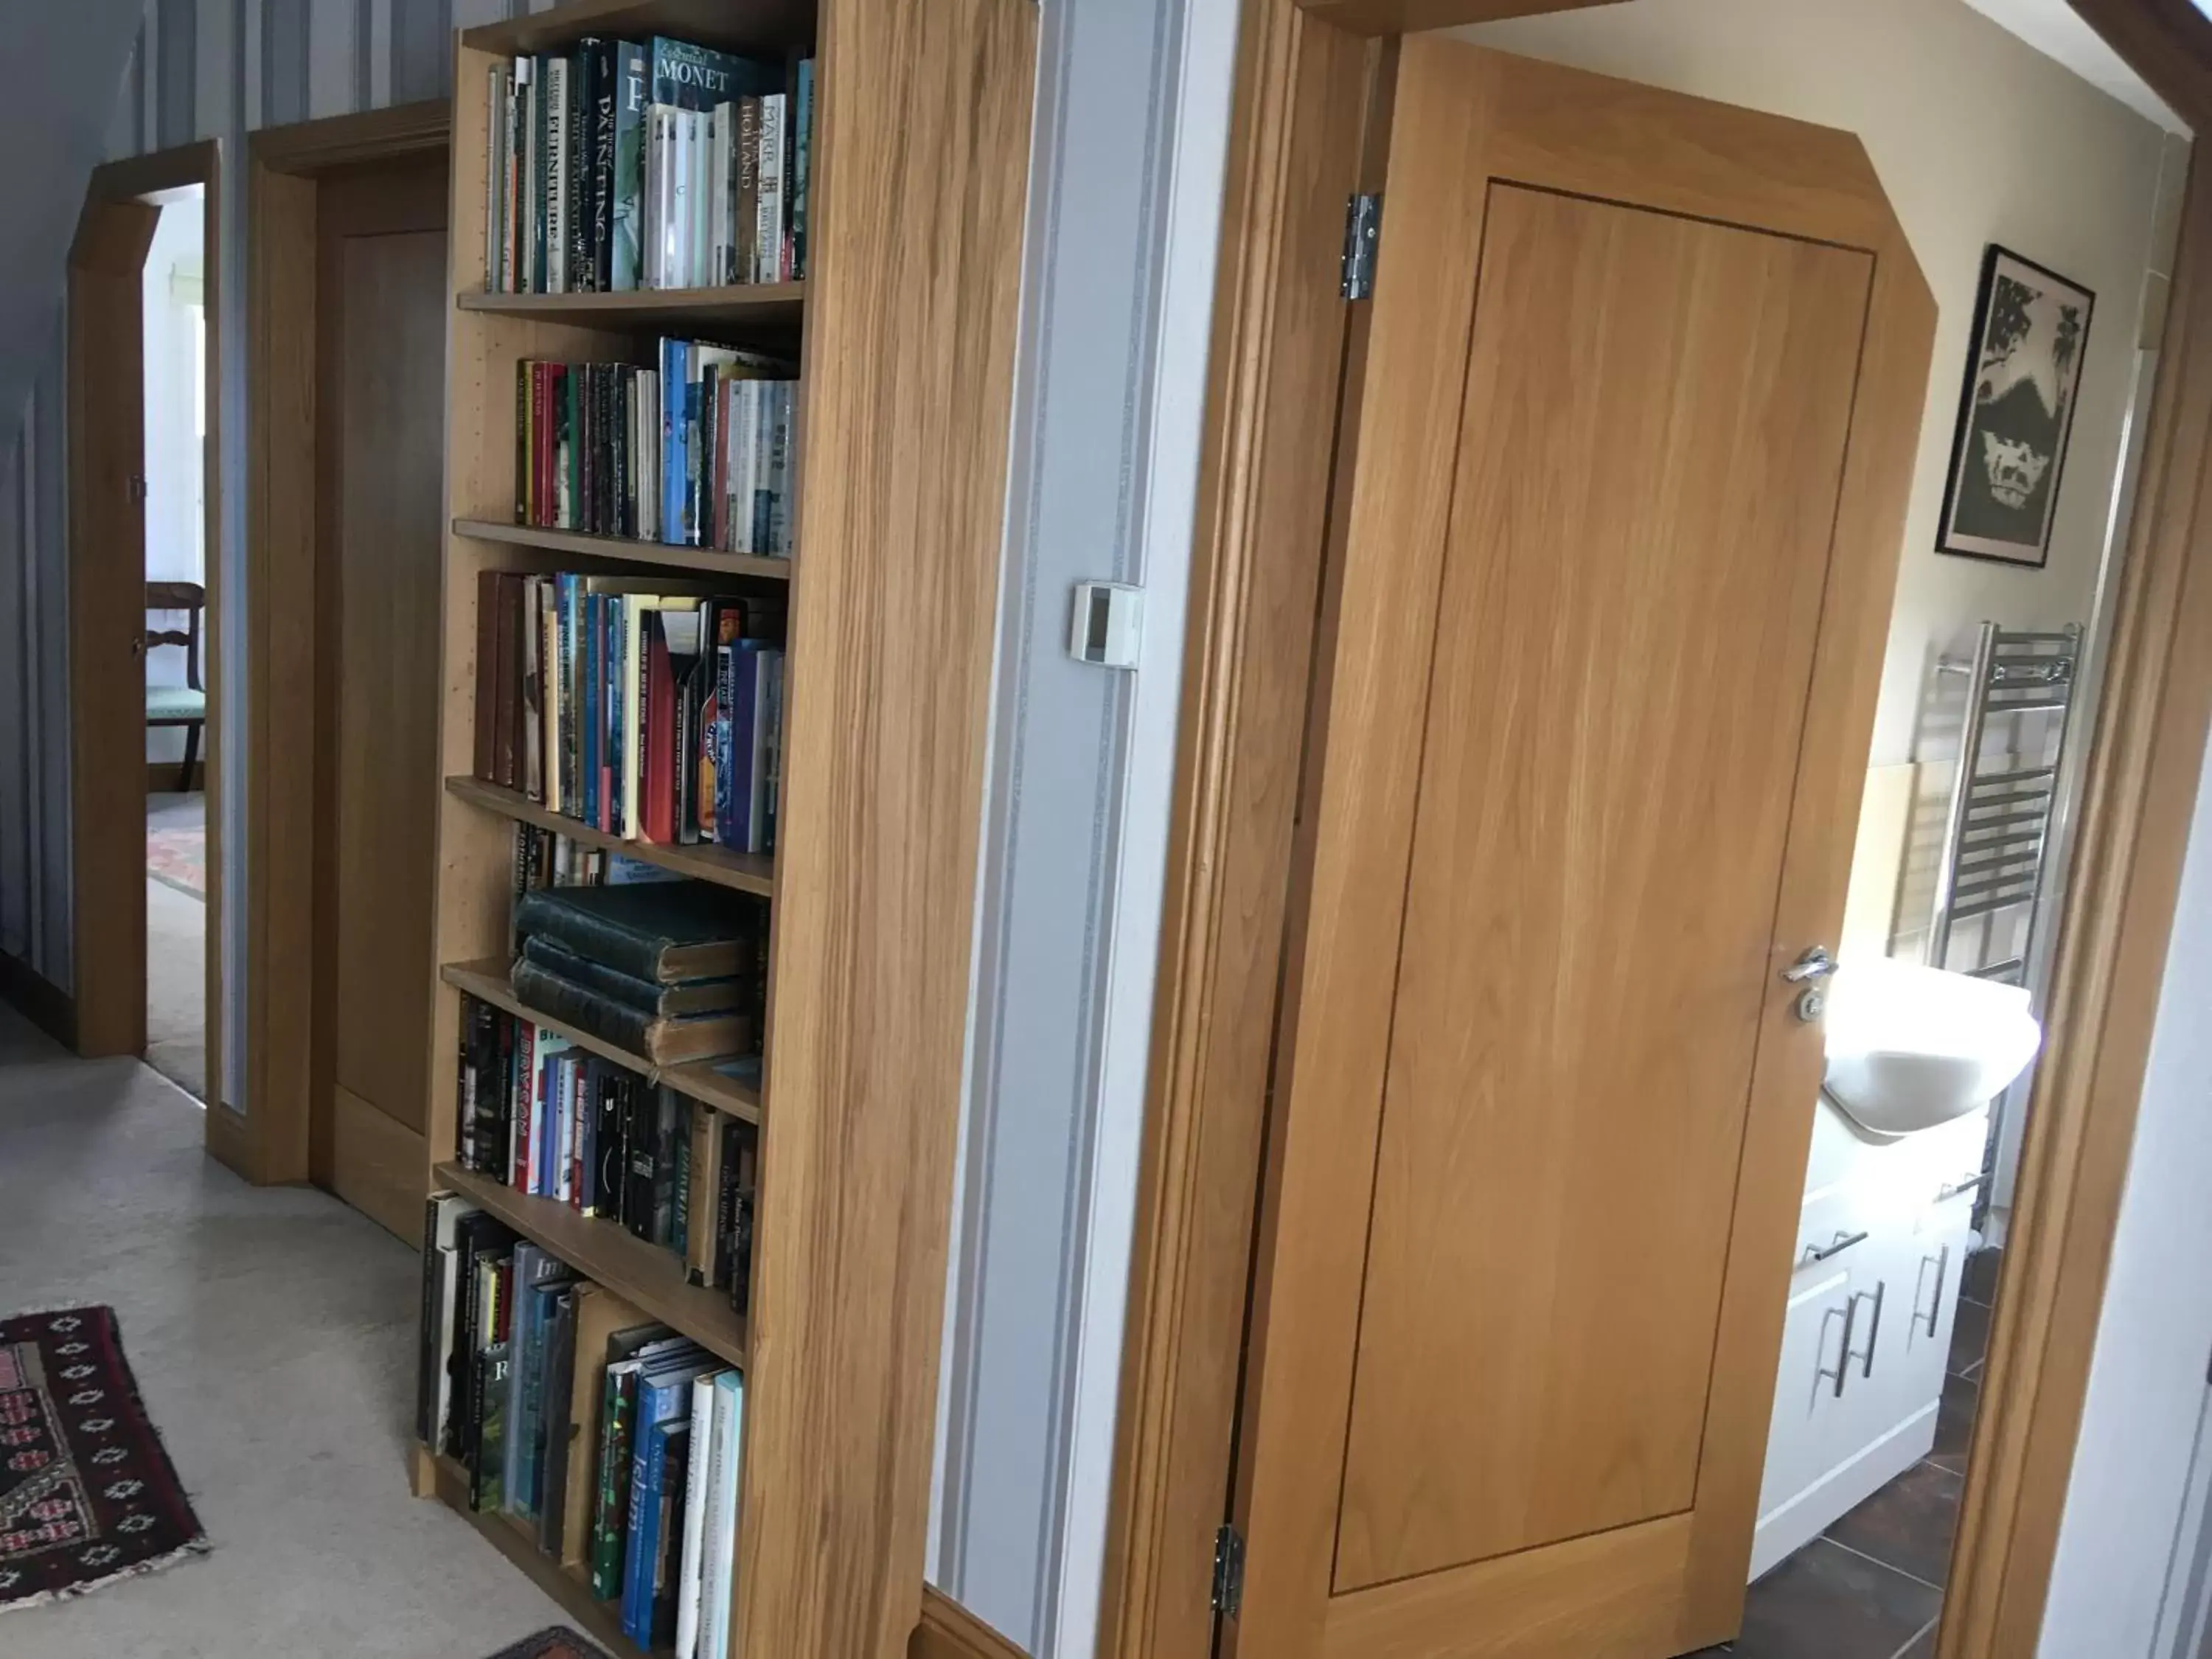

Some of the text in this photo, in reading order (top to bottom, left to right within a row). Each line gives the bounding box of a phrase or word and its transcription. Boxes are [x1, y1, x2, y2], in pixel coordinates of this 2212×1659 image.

[659, 61, 729, 93] MONET
[596, 94, 611, 242] PAINTING
[742, 105, 753, 189] HOLLAND
[763, 106, 775, 164] MARR
[549, 116, 559, 237] FURNITURE
[760, 207, 768, 259] BRITAIN
[518, 1039, 531, 1136] BRYSON
[678, 1144, 689, 1225] DARWIN
[628, 1453, 647, 1531] Islam
